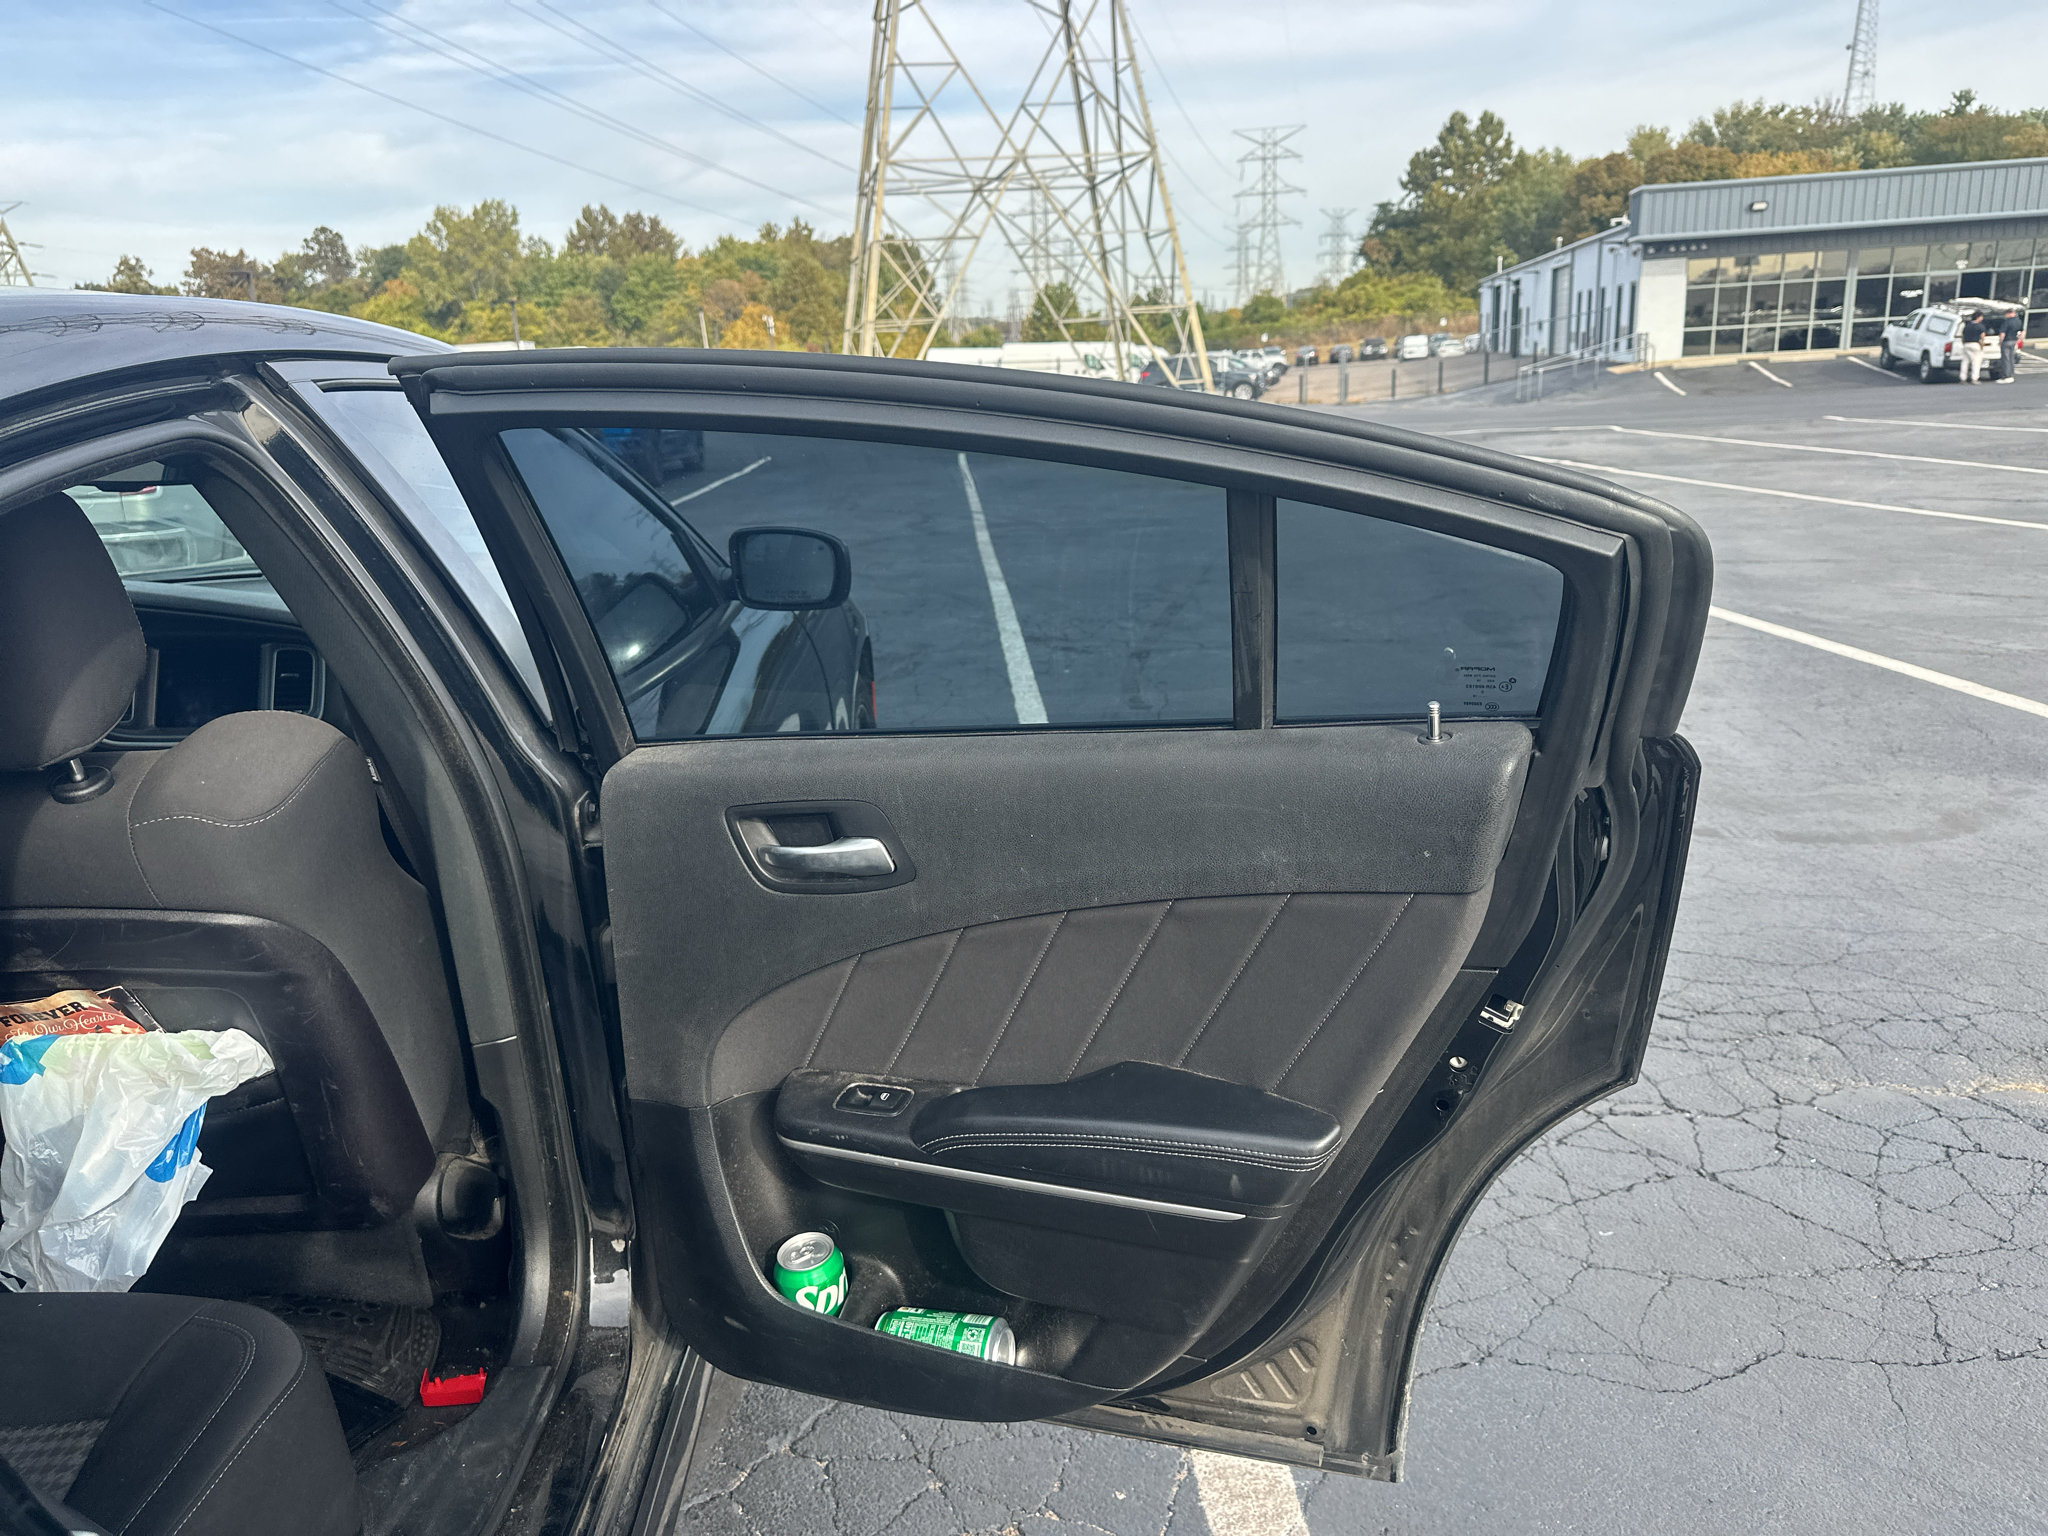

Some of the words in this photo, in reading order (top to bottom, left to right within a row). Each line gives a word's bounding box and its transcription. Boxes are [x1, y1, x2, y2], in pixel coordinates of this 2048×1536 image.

[0, 1001, 88, 1027] FOREVER
[32, 1023, 62, 1037] Our
[63, 1012, 116, 1031] Hearts
